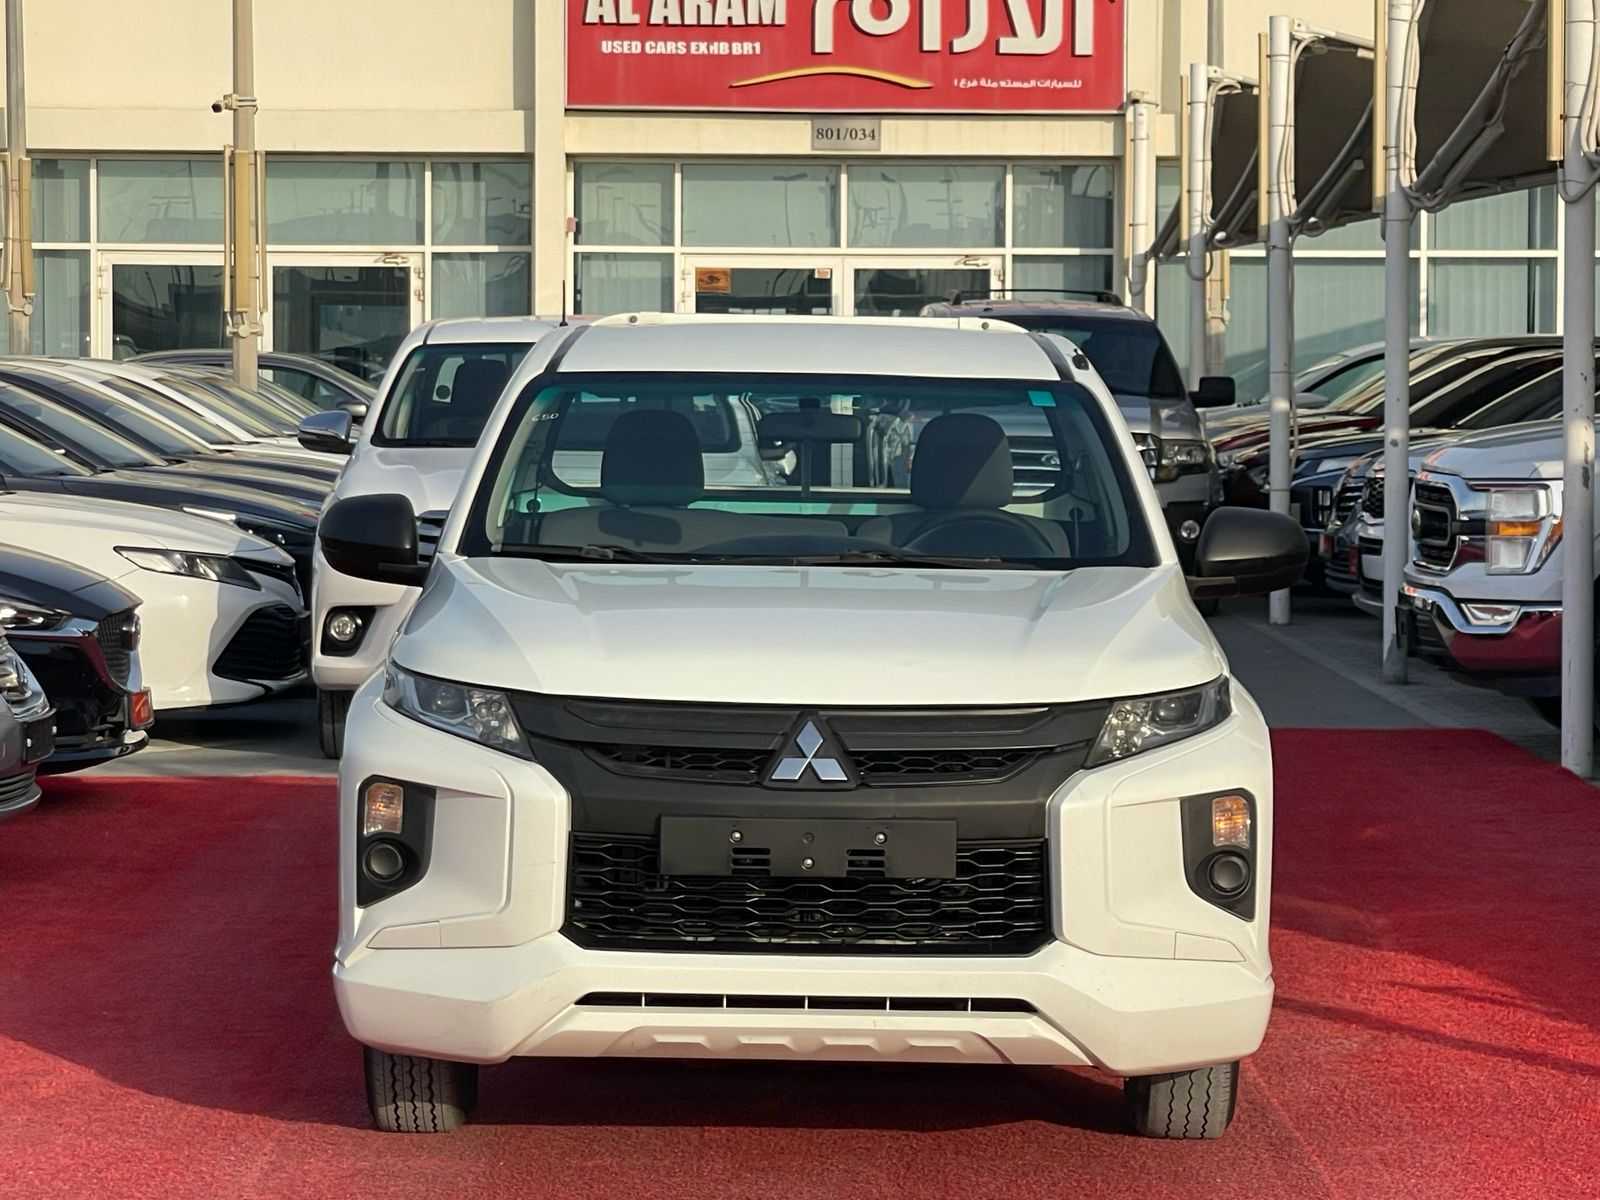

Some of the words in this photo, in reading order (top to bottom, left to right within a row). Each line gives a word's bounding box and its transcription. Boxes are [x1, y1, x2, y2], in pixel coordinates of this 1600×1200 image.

[585, 0, 640, 24] AL
[648, 0, 787, 25] ARAM
[601, 40, 642, 54] USED
[645, 41, 687, 55] CARS
[731, 41, 761, 55] BR1
[816, 127, 876, 141] 801/034
